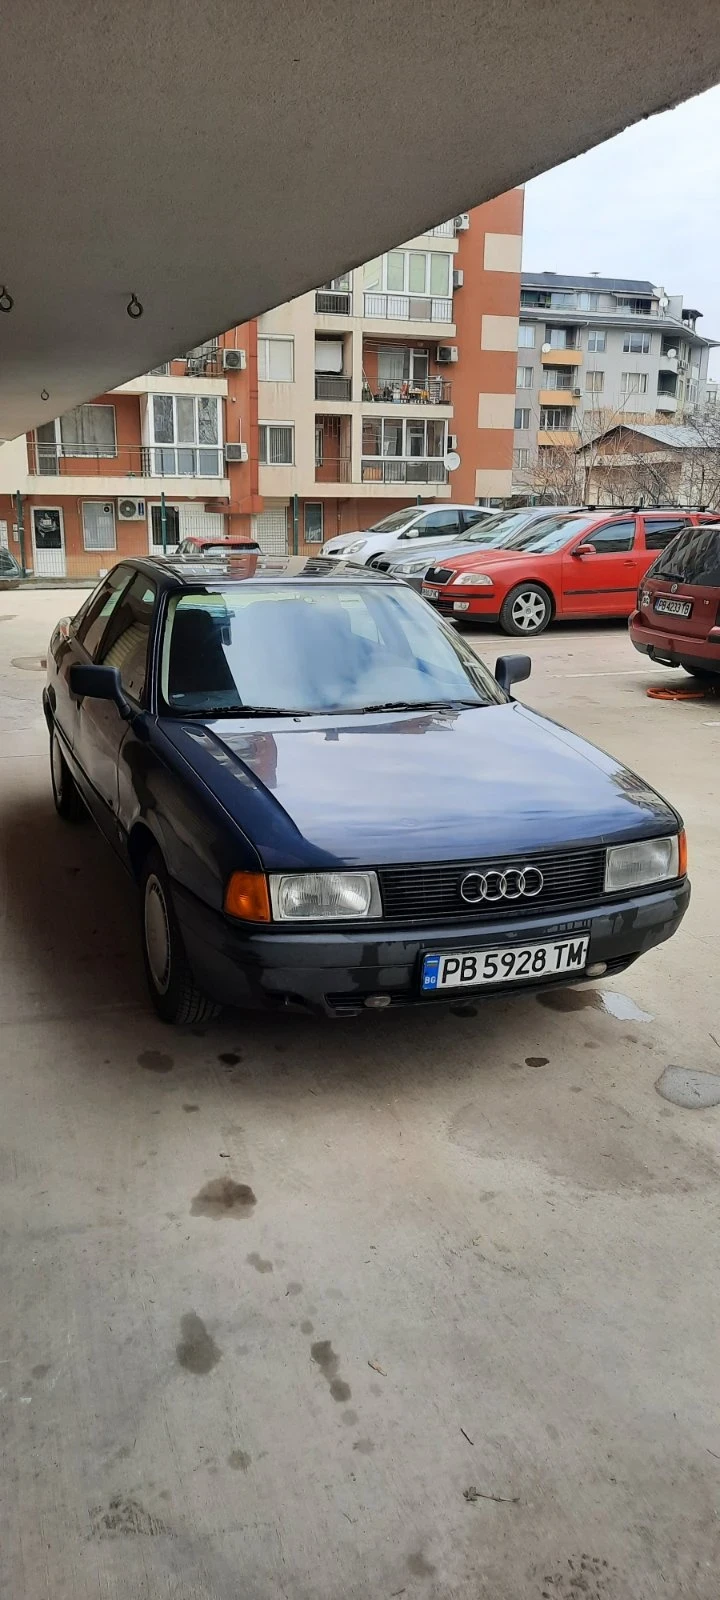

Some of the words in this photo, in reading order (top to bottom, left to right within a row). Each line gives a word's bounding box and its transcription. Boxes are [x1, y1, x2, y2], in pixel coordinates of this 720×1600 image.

[441, 956, 477, 984] PB
[482, 949, 546, 979] 5928
[554, 941, 585, 969] TM
